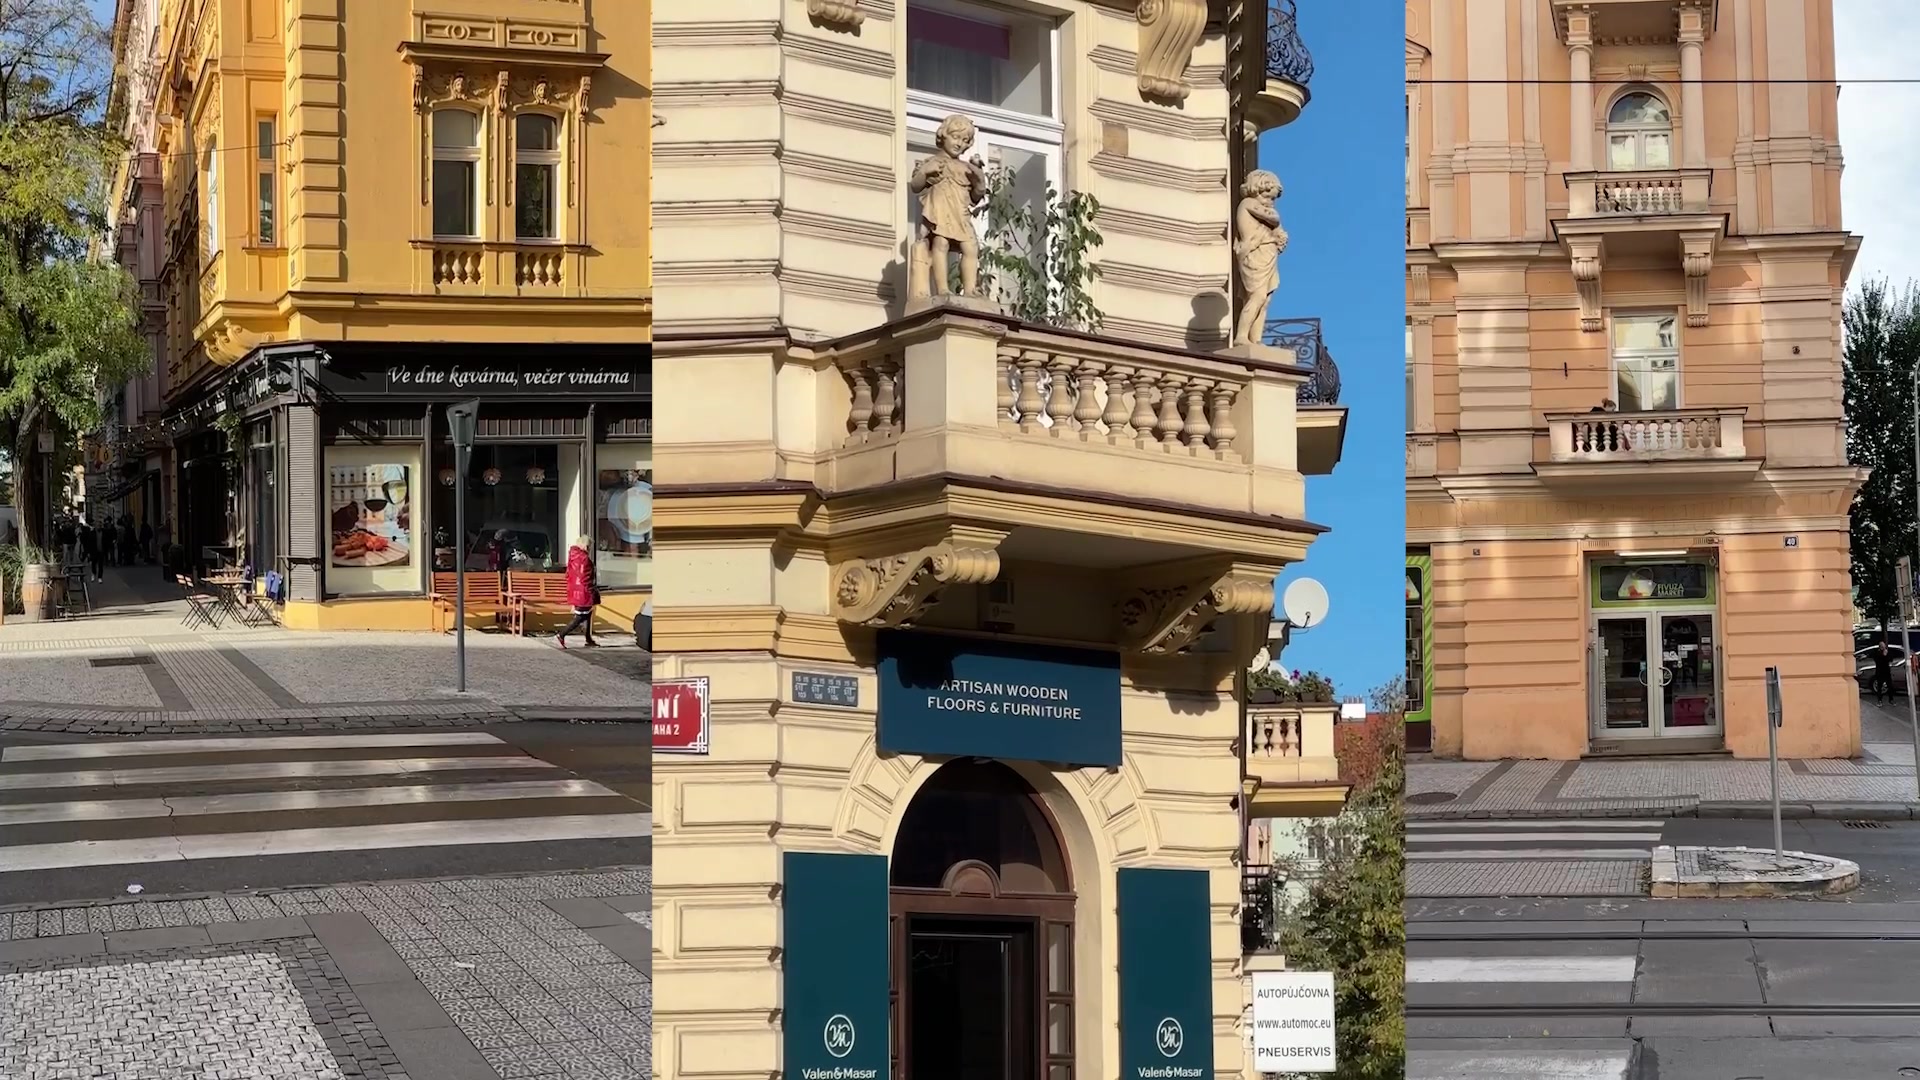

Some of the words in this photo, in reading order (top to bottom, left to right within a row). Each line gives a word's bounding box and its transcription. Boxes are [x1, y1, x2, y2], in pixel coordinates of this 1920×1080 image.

[388, 365, 411, 384] Ve
[415, 365, 445, 384] dne
[449, 365, 519, 388] kavárna,
[524, 368, 566, 385] večer
[568, 367, 630, 384] vinárna
[940, 679, 1003, 695] ARTISAN
[1007, 684, 1068, 701] WOODEN
[652, 694, 681, 719] NÍ
[927, 696, 986, 713] FLOORS
[989, 702, 1000, 714] &
[1003, 702, 1081, 720] FURNITURE
[652, 724, 672, 735] AHA
[673, 724, 680, 735] 2
[1257, 984, 1330, 998] AUTOPŮJČOVNA
[1257, 1018, 1331, 1029] www.automoc.eu
[1258, 1047, 1331, 1057] PNEUSERVIS
[802, 1067, 877, 1080] Valen&Masar
[1137, 1066, 1203, 1078] Valen&Masar
